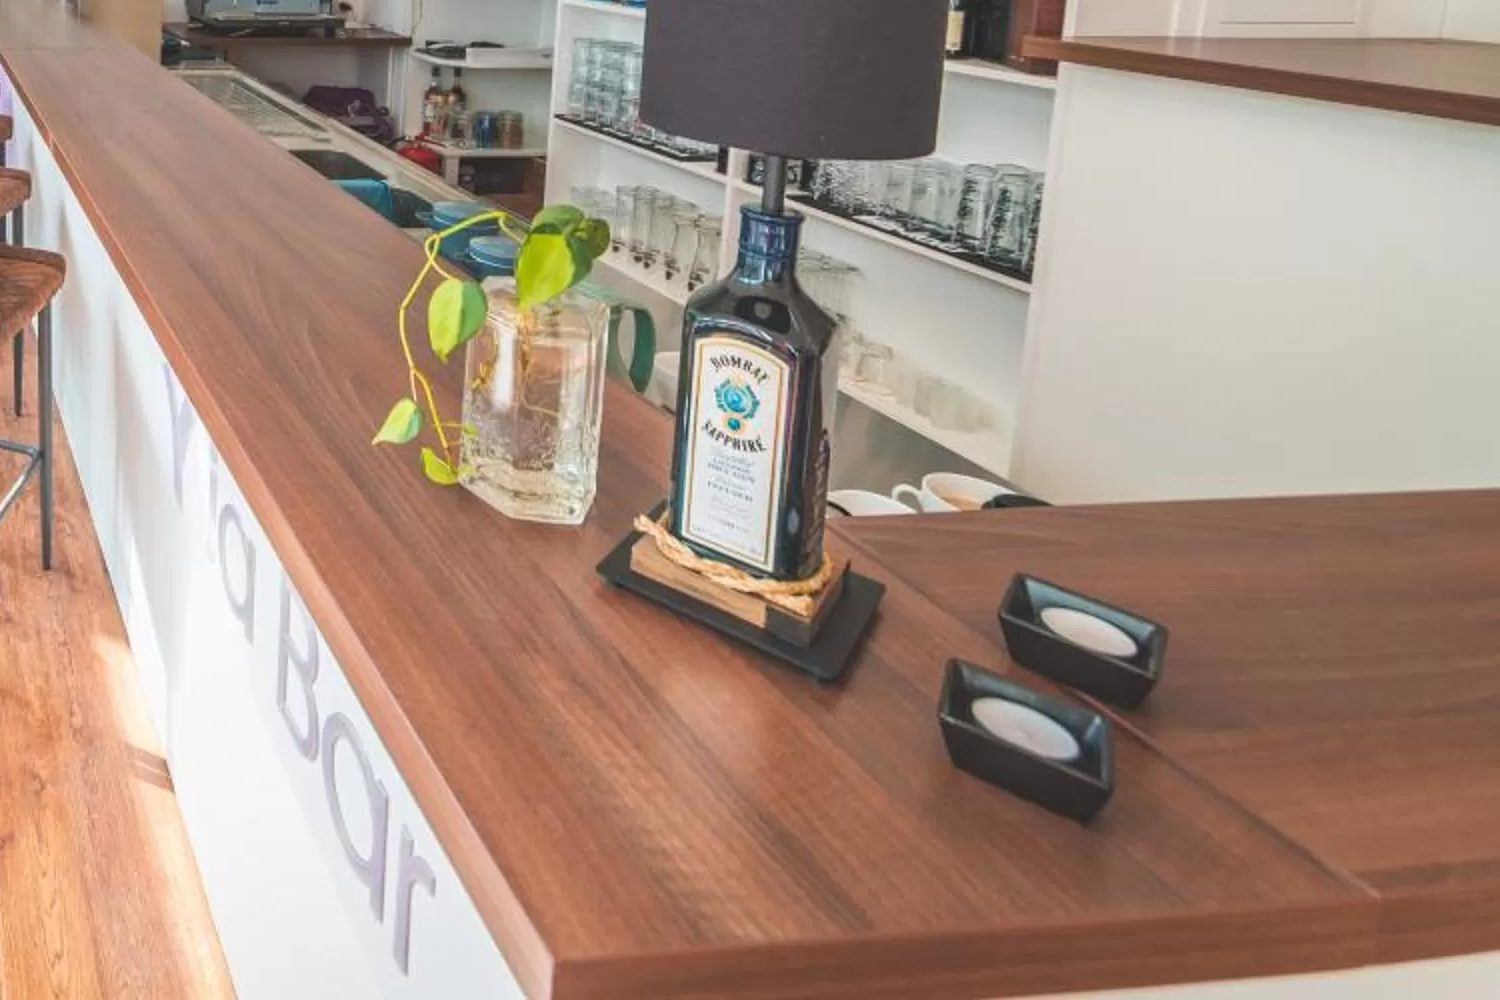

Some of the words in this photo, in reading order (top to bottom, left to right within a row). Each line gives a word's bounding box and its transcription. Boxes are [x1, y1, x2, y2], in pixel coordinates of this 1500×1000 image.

[710, 356, 768, 383] BOMBAY
[702, 420, 767, 452] SAPPHIRE
[277, 568, 436, 976] Bar
